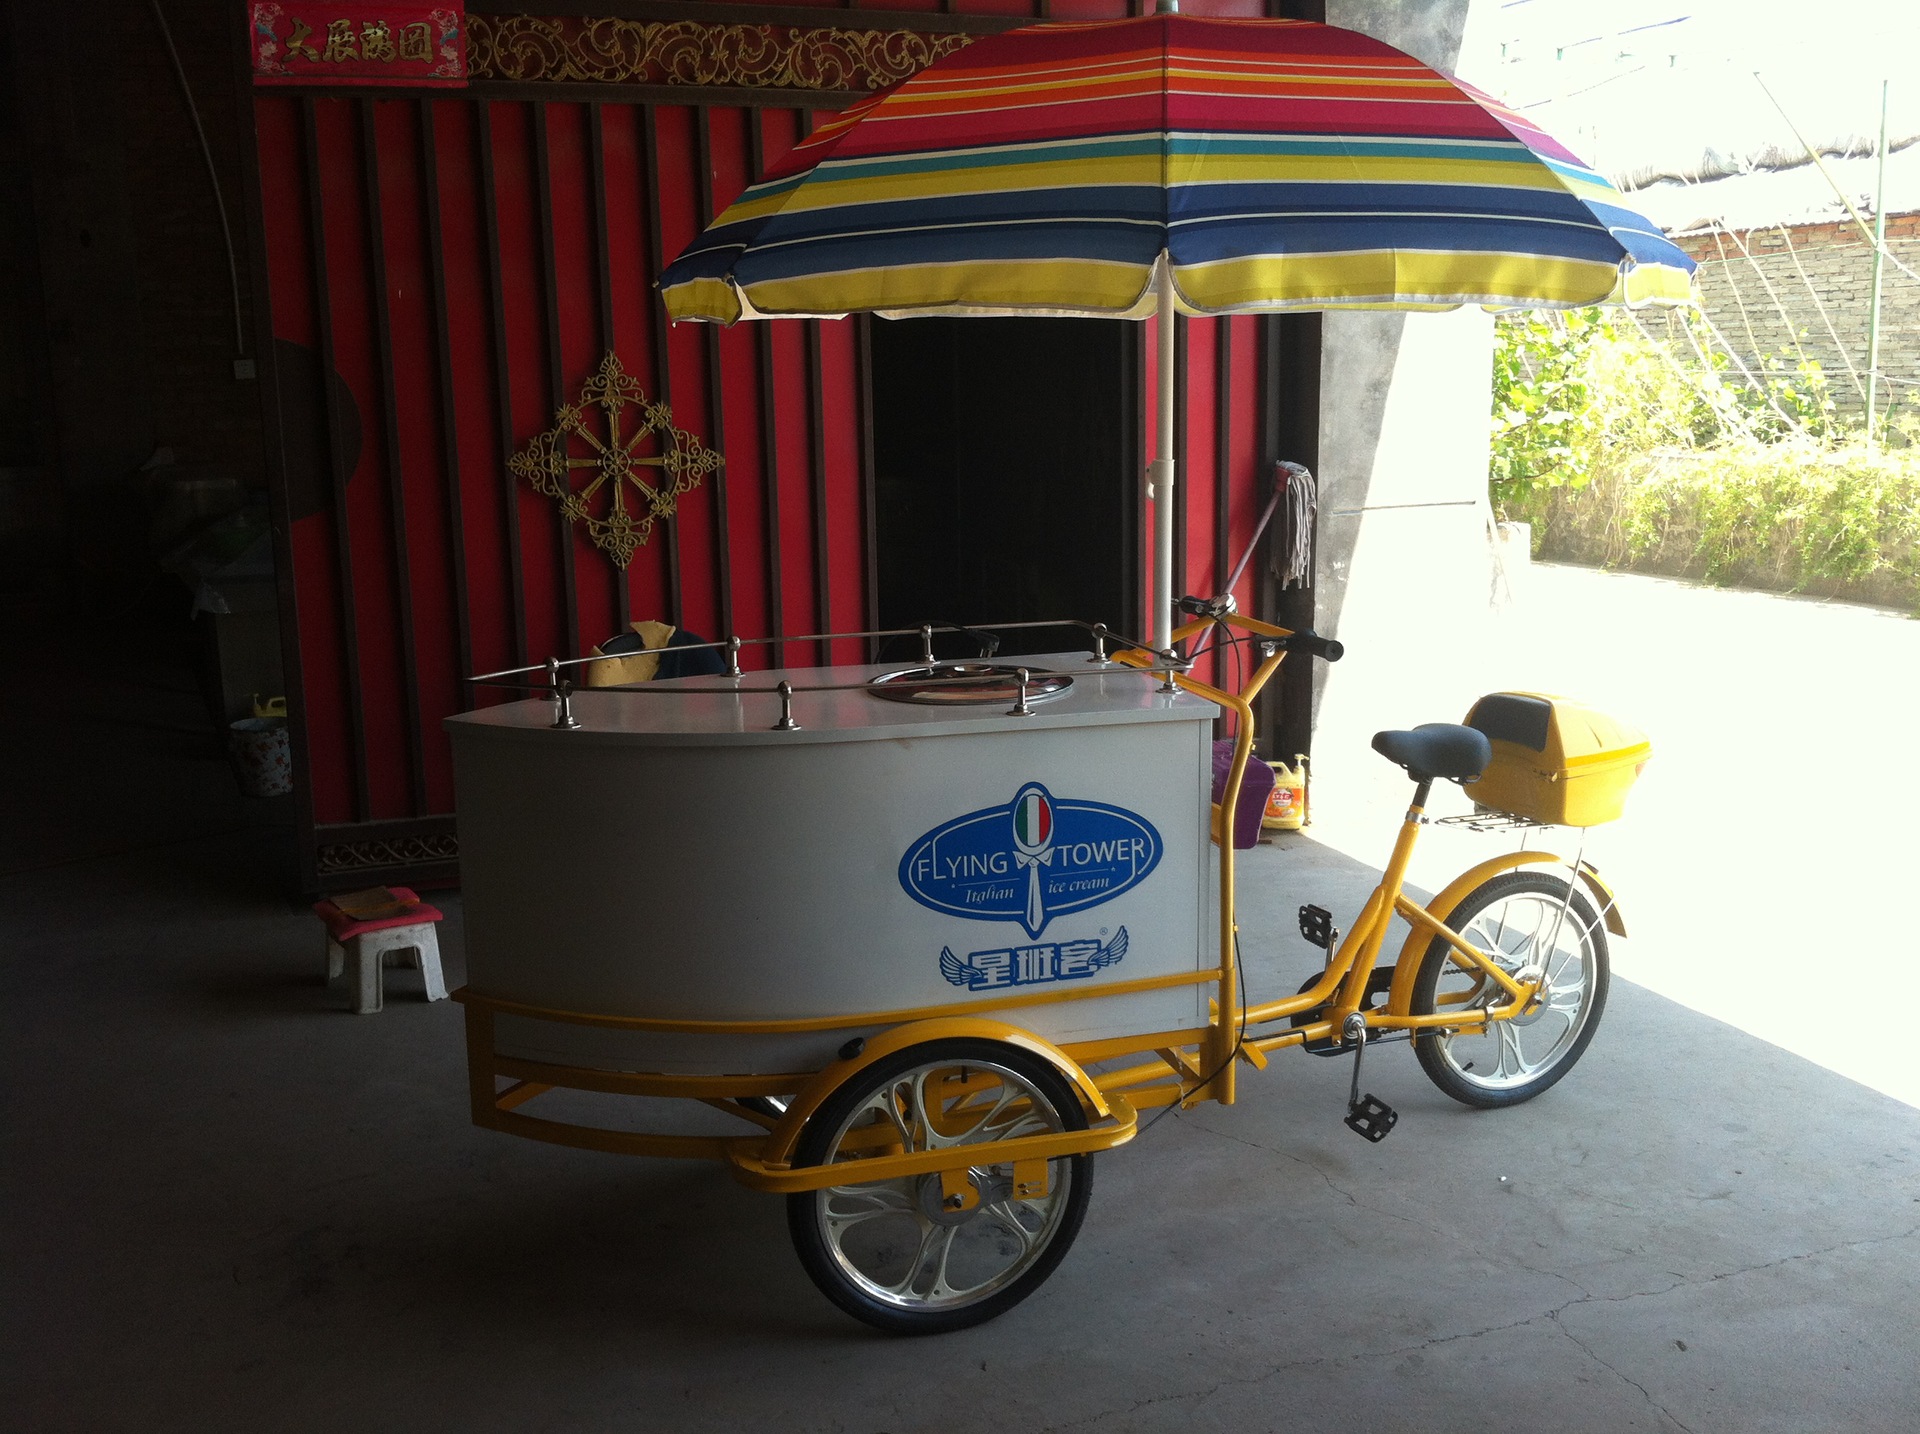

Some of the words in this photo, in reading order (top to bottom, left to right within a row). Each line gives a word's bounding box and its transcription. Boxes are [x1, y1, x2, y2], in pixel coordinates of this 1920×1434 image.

[917, 841, 1009, 882] FLYING
[1055, 837, 1146, 868] TOWER
[964, 884, 1014, 905] Italian
[1048, 879, 1067, 894] ice
[1068, 876, 1110, 891] cream
